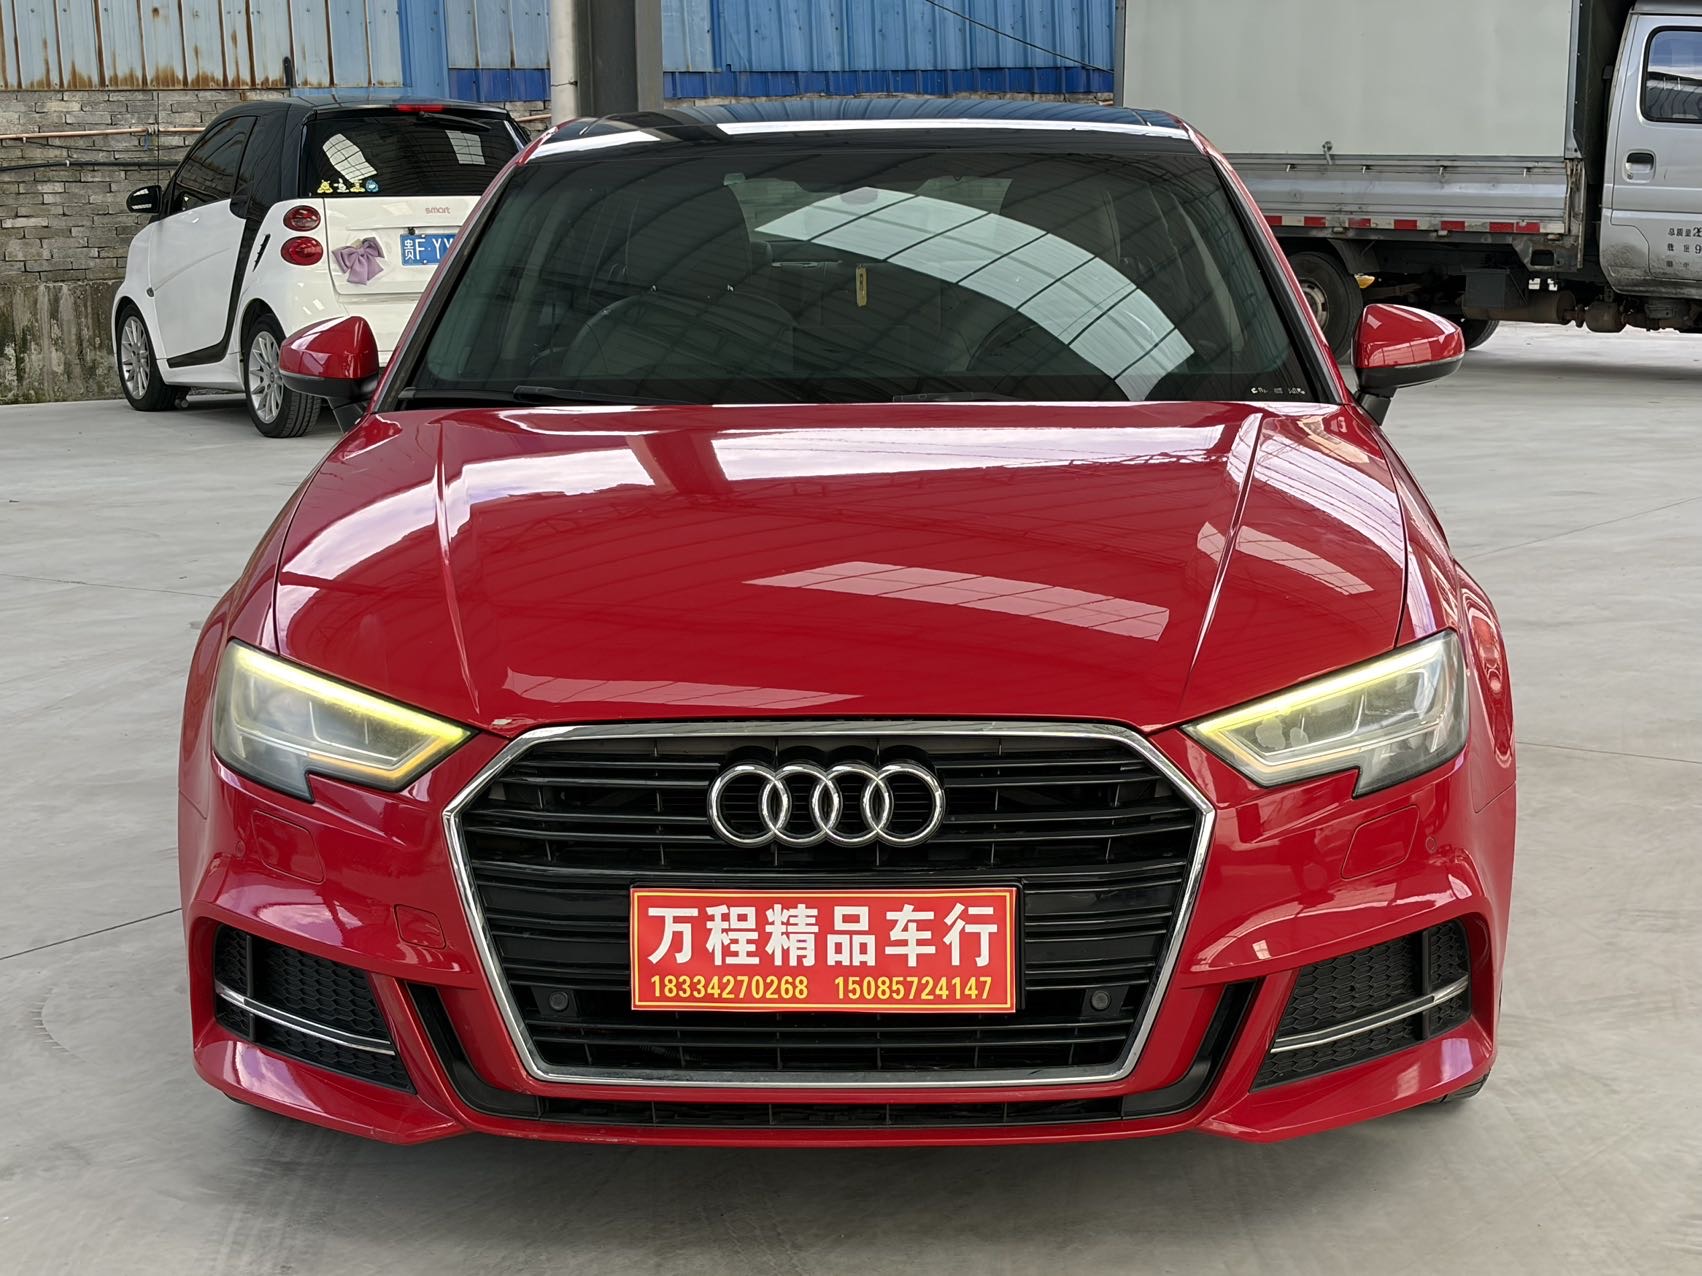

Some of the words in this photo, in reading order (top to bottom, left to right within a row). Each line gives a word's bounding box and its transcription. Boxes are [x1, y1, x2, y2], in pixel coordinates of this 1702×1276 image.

[648, 903, 998, 967] 万程精品车行
[650, 975, 809, 999] 18334270268
[834, 976, 992, 1000] 15085724147
